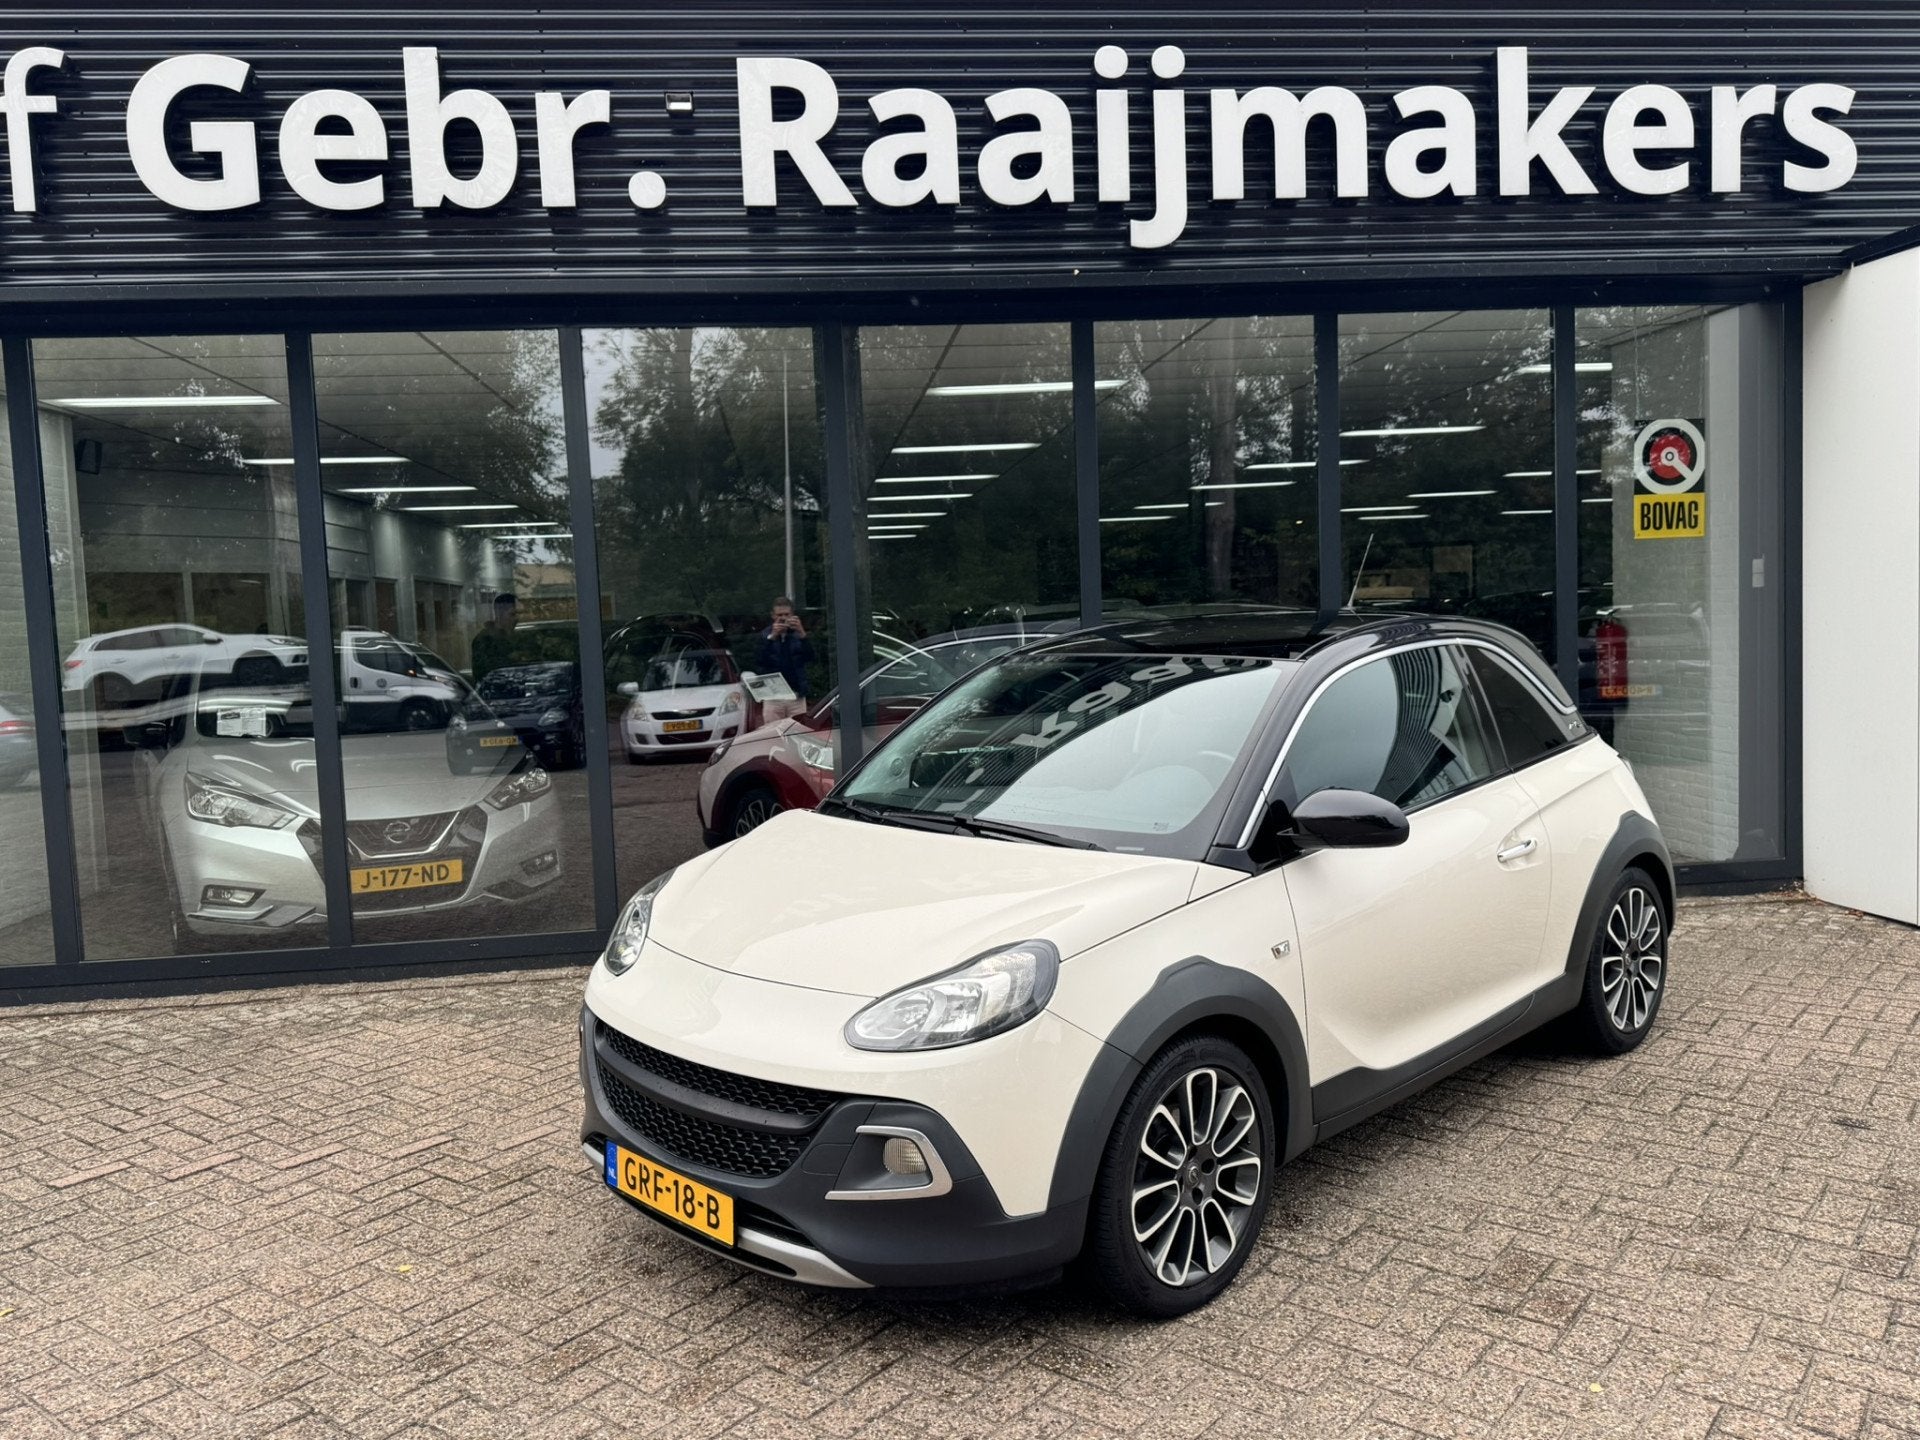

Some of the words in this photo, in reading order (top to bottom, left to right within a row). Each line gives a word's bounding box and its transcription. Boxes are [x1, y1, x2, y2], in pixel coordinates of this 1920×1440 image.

[0, 46, 65, 212] f
[126, 47, 667, 211] Gebr.
[736, 45, 1858, 249] Raaijmakers
[1641, 501, 1699, 530] BOVAG
[361, 864, 450, 889] J-177-ND
[624, 1157, 720, 1230] GRF-18-B
